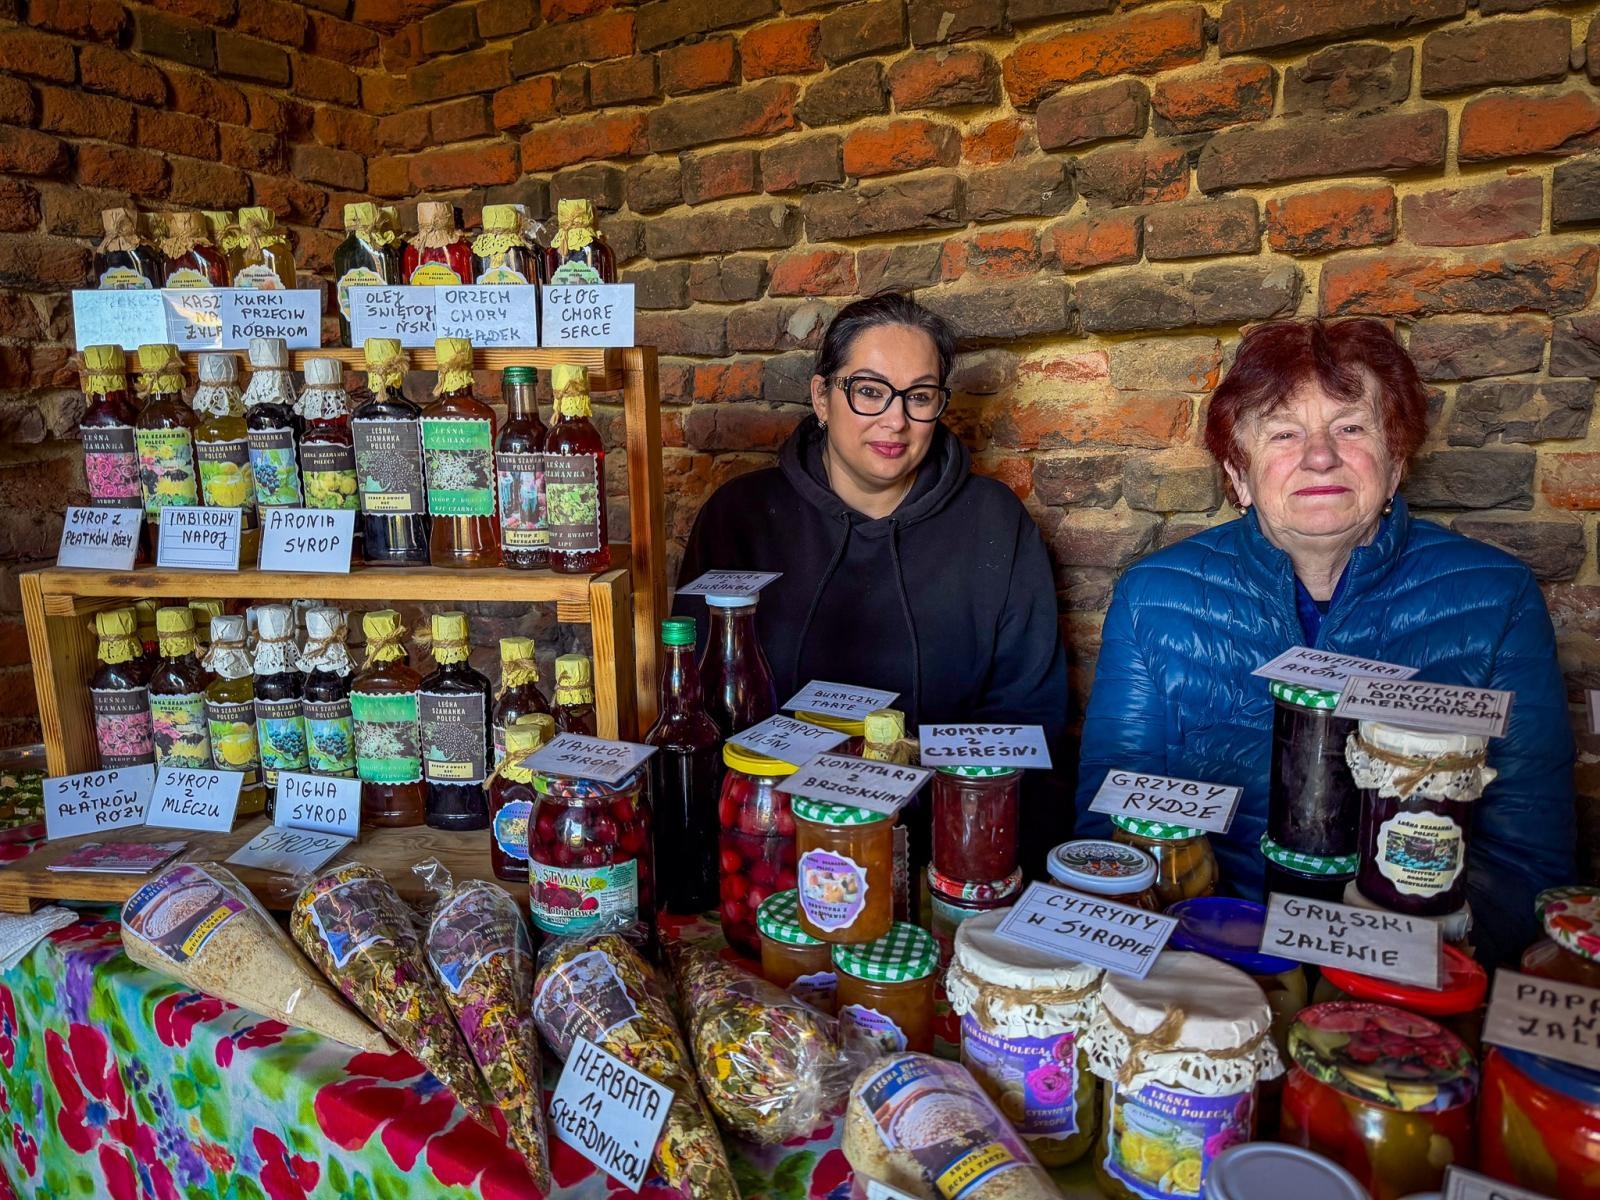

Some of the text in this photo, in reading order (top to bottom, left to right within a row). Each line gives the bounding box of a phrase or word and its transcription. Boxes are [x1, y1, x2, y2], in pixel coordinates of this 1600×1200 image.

[234, 294, 283, 306] KURKI
[446, 290, 510, 304] ORZECH
[241, 308, 304, 320] PRZECIW
[451, 309, 507, 322] CHORY
[562, 304, 613, 322] CHORE
[561, 322, 610, 339] SERCE
[72, 510, 108, 524] SYROP
[170, 511, 234, 526] IMBIROWY
[270, 510, 335, 528] ARONIA
[284, 537, 340, 553] SYROP
[1296, 650, 1400, 675] KONFITURA
[1367, 682, 1496, 702] KONFITURA
[810, 700, 856, 711] TARTE
[767, 717, 835, 739] KOMPOT
[932, 726, 1023, 737] KOMPOT
[924, 742, 1037, 757] CZEREŚNI
[815, 757, 917, 782] KONFITURA
[59, 772, 118, 793] SYROP
[165, 772, 219, 790] SYROP
[285, 781, 337, 798] PIGWA
[1112, 773, 1226, 800] GRZYBY
[162, 798, 220, 818] MLECZU
[292, 804, 348, 825] SYROP
[1122, 792, 1222, 819] RYDZE
[1046, 895, 1159, 930] CYTRYNY
[1283, 899, 1413, 933] GRUSZKI
[1054, 920, 1156, 957] SYROPIE
[1276, 928, 1399, 966] ZALEWIE
[1003, 1042, 1046, 1055] POLECA
[573, 1042, 660, 1121] HERBATA
[579, 1092, 603, 1119] 11
[1152, 1090, 1190, 1107] LEŚNA
[550, 1098, 646, 1184] SKŁADNIKÓW
